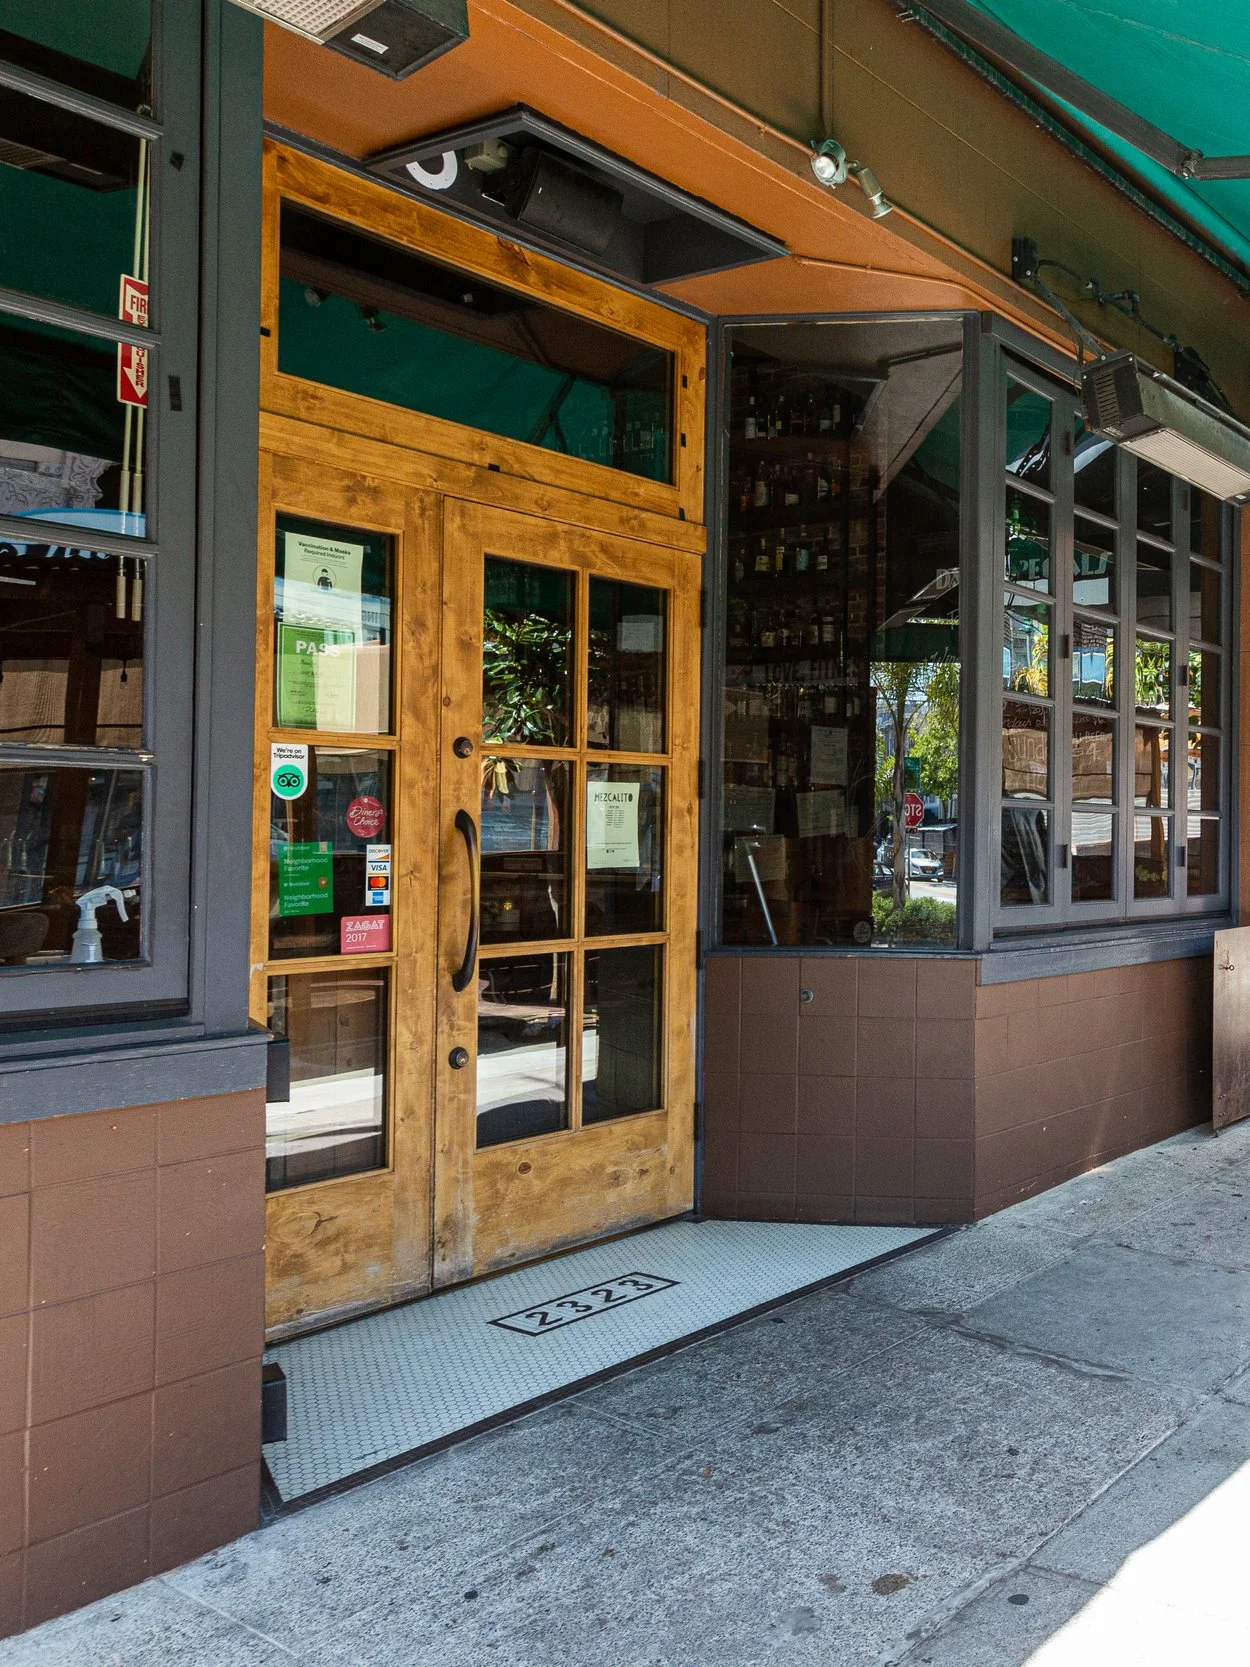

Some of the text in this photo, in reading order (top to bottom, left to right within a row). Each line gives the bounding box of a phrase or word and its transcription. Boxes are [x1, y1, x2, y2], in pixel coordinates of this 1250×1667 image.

[130, 294, 147, 314] FIR
[298, 541, 329, 552] Vaccination
[334, 547, 351, 556] Masks
[304, 548, 345, 560] Required Indoors
[296, 640, 341, 657] PASS
[594, 792, 633, 802] MEZCALITO
[353, 816, 380, 826] Choice
[284, 893, 328, 901] Neighborhood
[346, 920, 384, 932] ZAGAT
[346, 933, 367, 943] 2017
[525, 1279, 653, 1327] 2323
